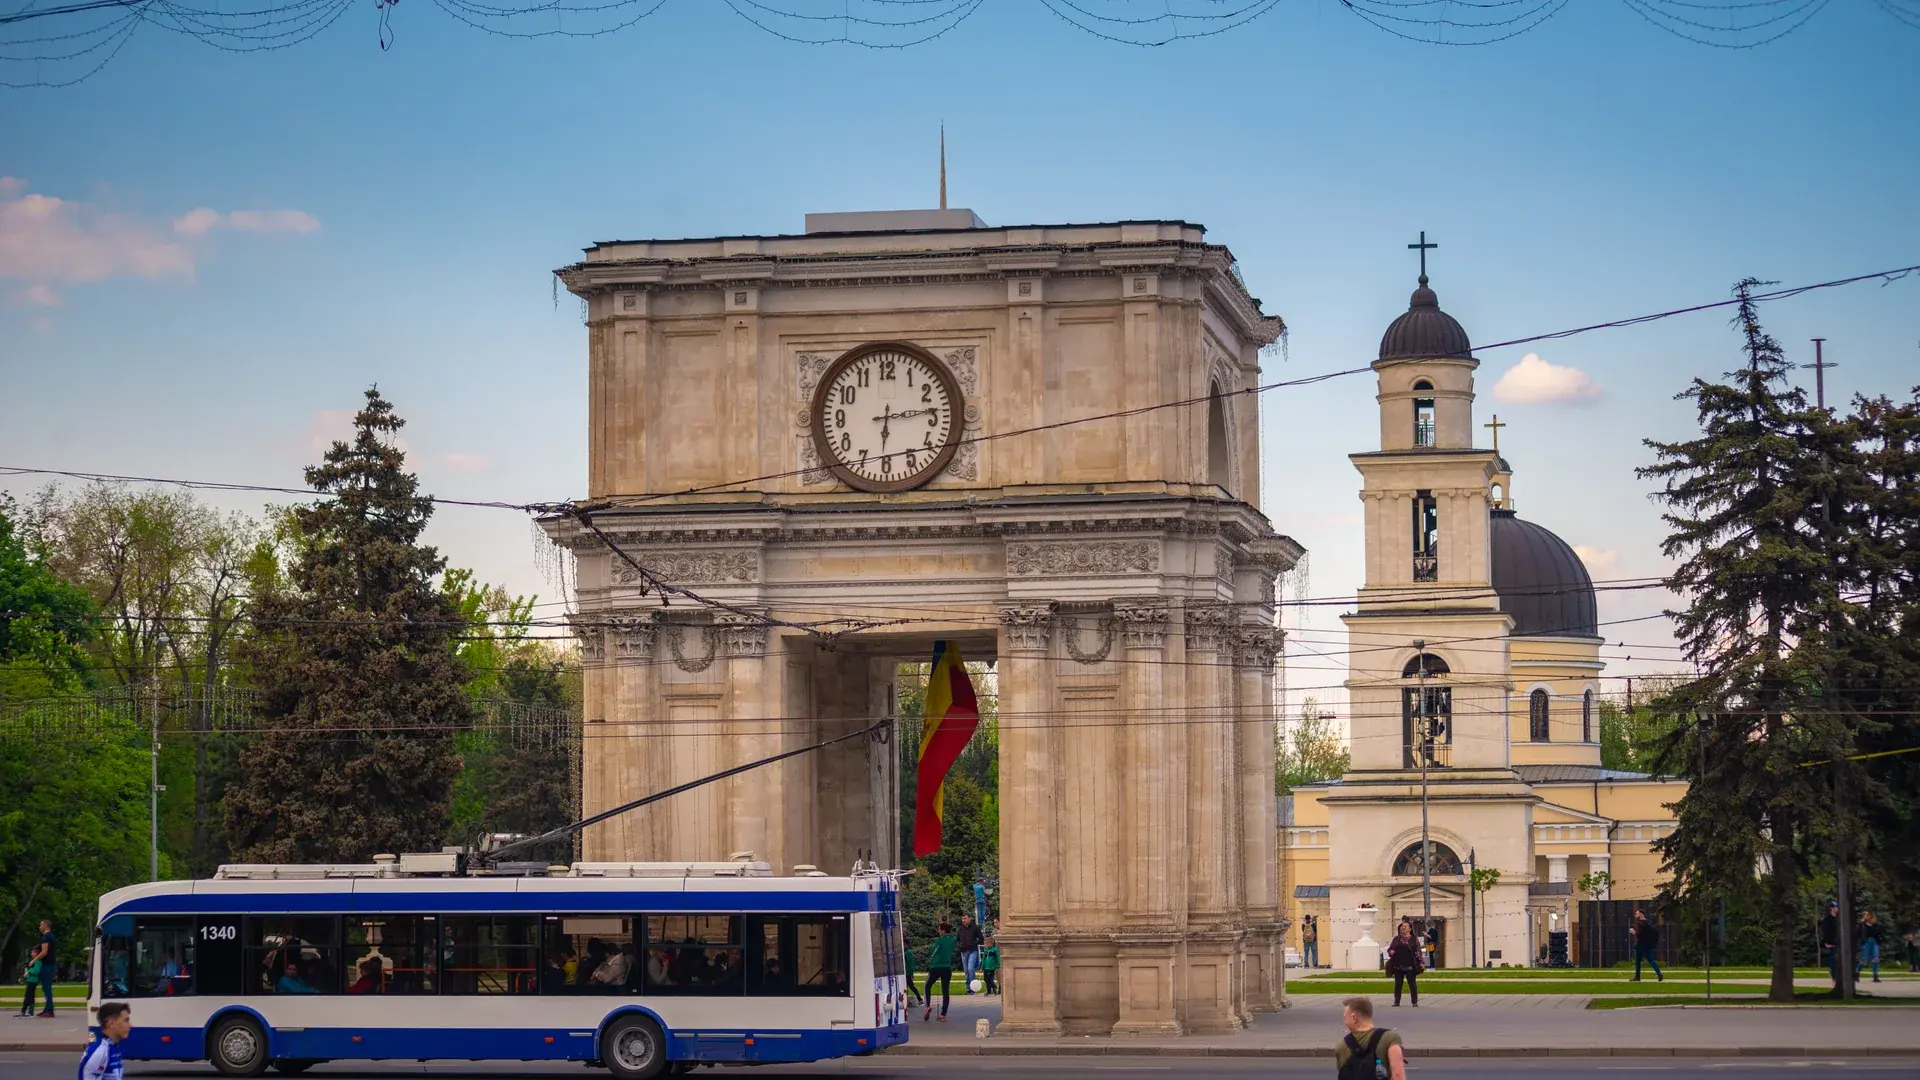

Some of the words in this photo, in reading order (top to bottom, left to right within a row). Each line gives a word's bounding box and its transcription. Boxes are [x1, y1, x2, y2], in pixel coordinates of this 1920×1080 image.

[857, 367, 869, 387] 11
[879, 361, 896, 380] 12
[906, 367, 913, 387] 1
[839, 385, 856, 405] 10
[921, 384, 932, 402] 2
[835, 409, 846, 428] 9
[928, 408, 938, 427] 3
[841, 432, 851, 451] 8
[923, 431, 933, 449] 4
[858, 449, 868, 468] 7
[881, 455, 892, 474] 6
[906, 448, 916, 468] 5
[200, 926, 236, 940] 1340
